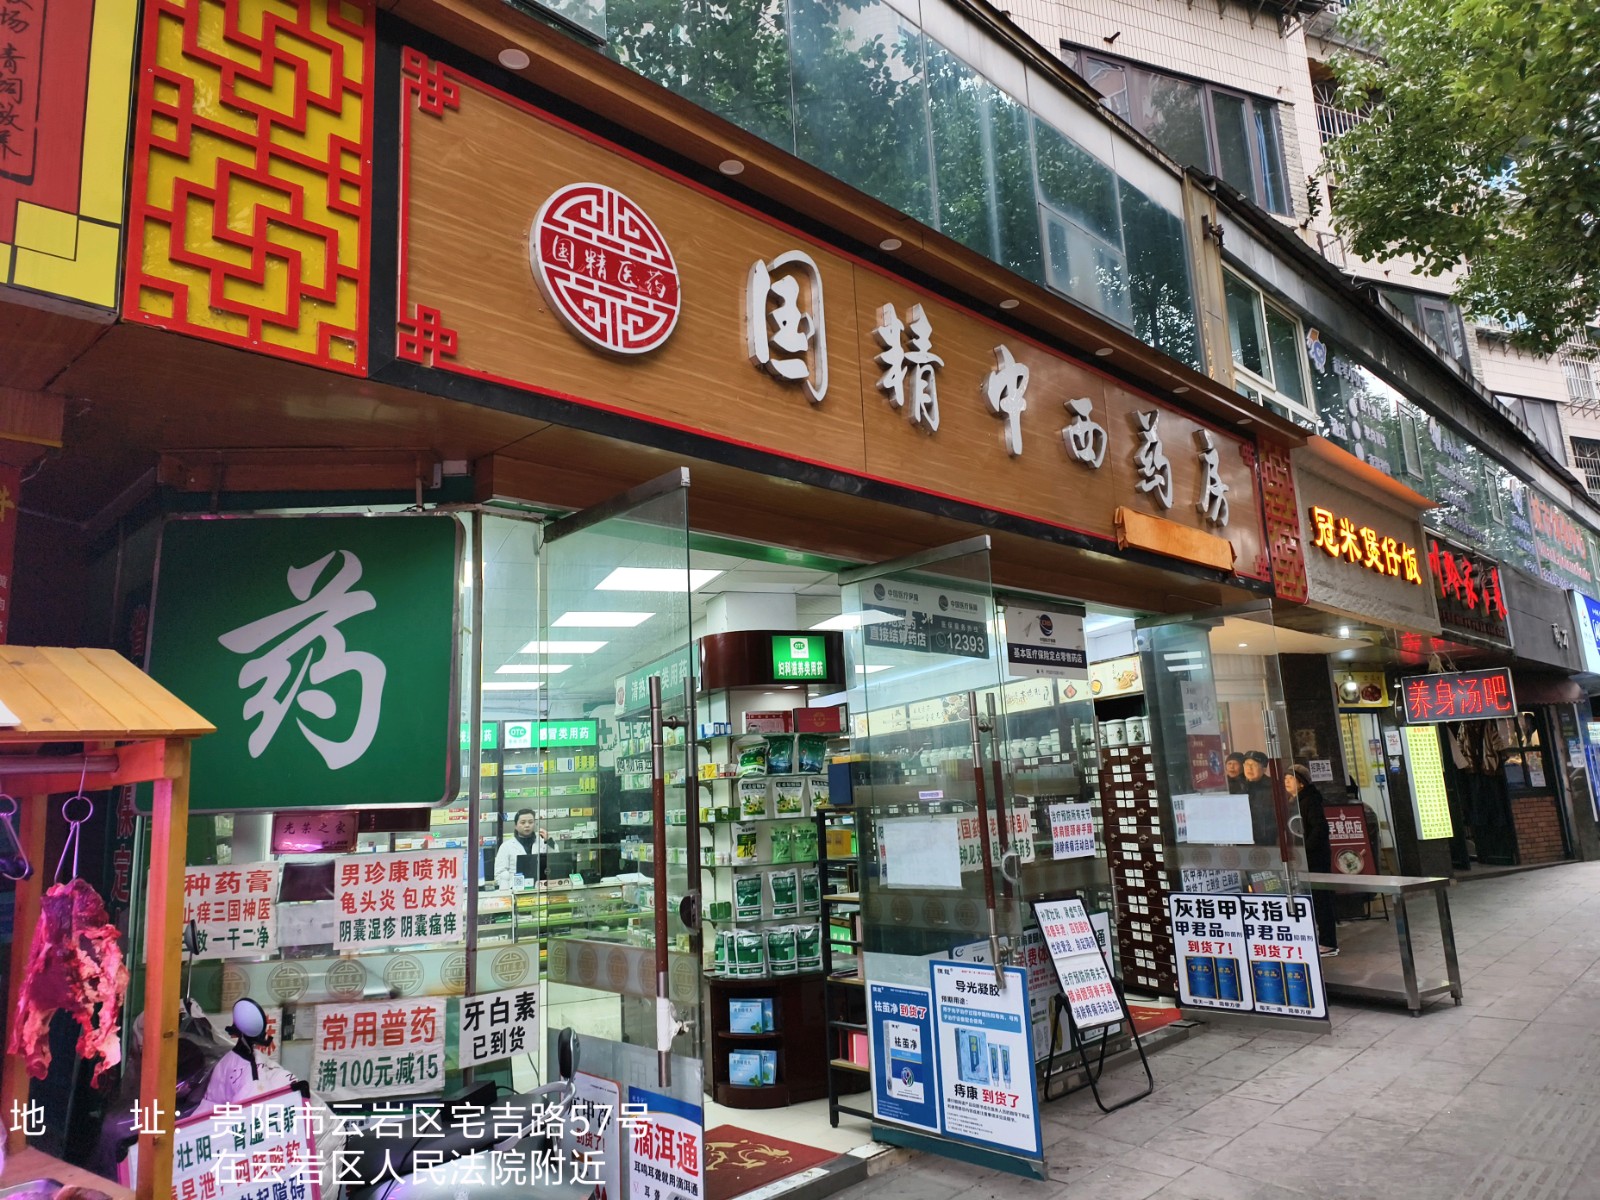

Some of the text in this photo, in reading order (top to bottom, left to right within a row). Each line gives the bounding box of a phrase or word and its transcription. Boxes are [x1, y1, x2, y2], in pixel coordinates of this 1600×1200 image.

[552, 234, 667, 299] 国精医药
[746, 249, 1230, 528] 国精中西药房
[1309, 506, 1423, 585] 冠米煲仔饭
[947, 632, 984, 654] 12393
[1013, 647, 1083, 664] 基本医疗保险定点零售药店
[217, 550, 387, 770] 药
[777, 660, 825, 677] 妇科滋养类用药
[631, 658, 688, 702] 清热类用药
[1408, 675, 1511, 719] 养身汤吧
[510, 727, 525, 737] OTC
[540, 727, 590, 742] 感冒类用药
[283, 820, 347, 836] 光荣之家
[1326, 819, 1363, 834] 早餐供应
[339, 855, 458, 888] 男珍康喷剂
[339, 884, 457, 916] 龟头炎 包皮炎
[1174, 897, 1237, 920] 灰指甲
[1243, 900, 1307, 923] 灰指甲
[212, 924, 270, 951] 一干二净
[338, 911, 458, 943] 阴囊湿疹 阴囊瘙痒
[1175, 921, 1224, 938] 甲君品
[1244, 924, 1293, 942] 甲君品
[955, 980, 1001, 997] 导光凝胶
[462, 991, 537, 1033] 牙白素
[899, 1003, 928, 1019] 到货了
[321, 1006, 438, 1053] 常用普药
[472, 1027, 527, 1060] 已到货
[316, 1050, 439, 1093] 满100元减15
[953, 1083, 1020, 1109] 痔康 到货了
[633, 1117, 699, 1177] 滴洱通
[633, 1160, 699, 1197] 耳鸣耳聋就用滴洱通
